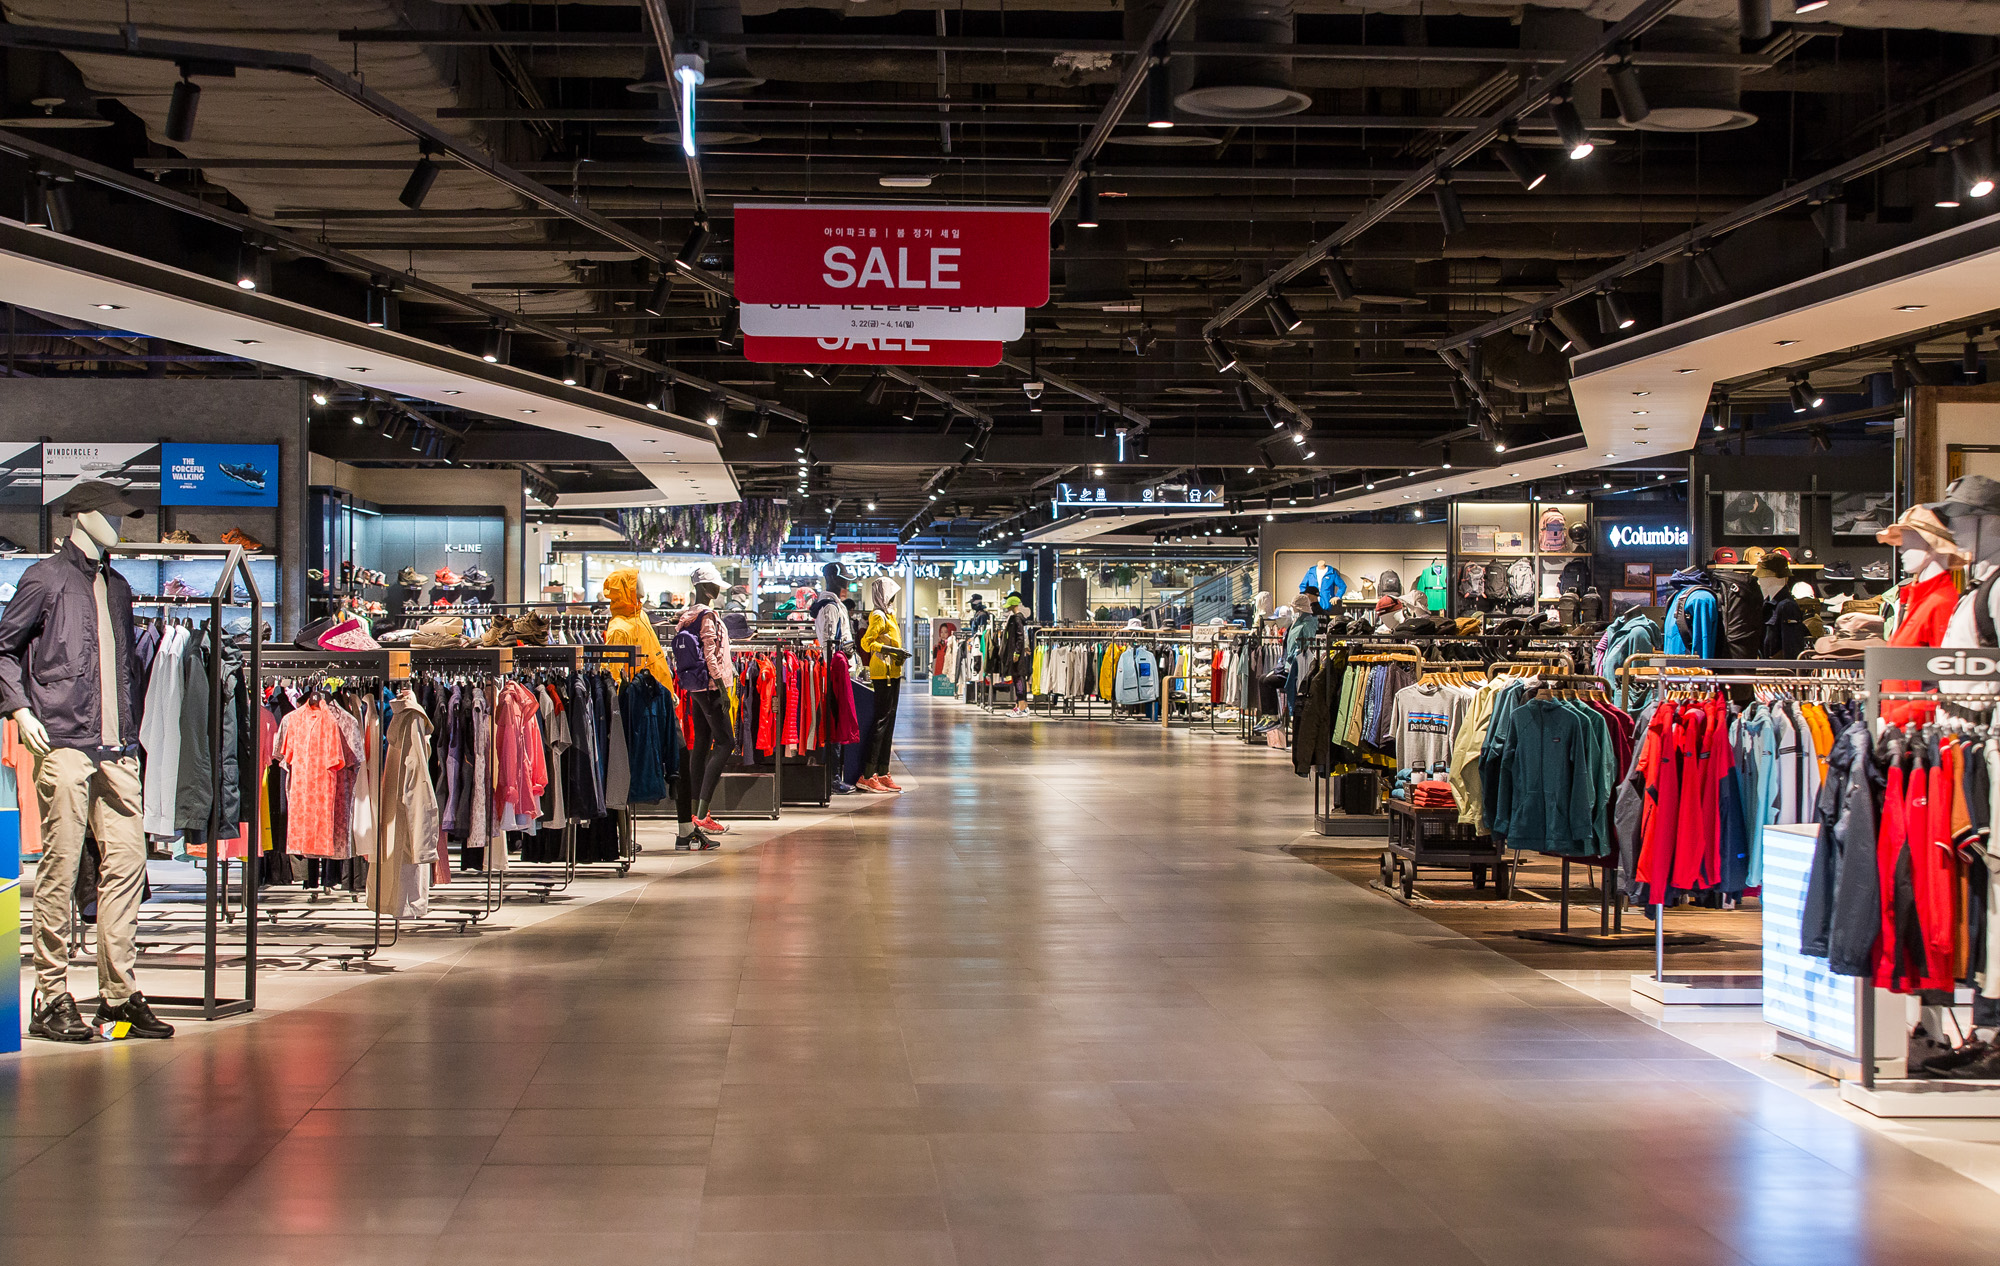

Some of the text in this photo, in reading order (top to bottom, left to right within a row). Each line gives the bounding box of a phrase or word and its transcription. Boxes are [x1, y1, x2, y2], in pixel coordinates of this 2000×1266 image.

[824, 228, 960, 239] 아이파크몰 봄 정기 세일
[822, 245, 961, 289] SALE
[46, 448, 99, 456] WINDCIRCLE 2
[182, 457, 195, 465] THE
[171, 465, 206, 473] FORCEFUL
[171, 473, 205, 481] WALKING
[1620, 525, 1689, 546] Columbia
[444, 543, 482, 553] K-LINE
[953, 559, 1000, 576] JAJU
[1200, 594, 1227, 603] JAJU
[1410, 723, 1446, 733] patagonia
